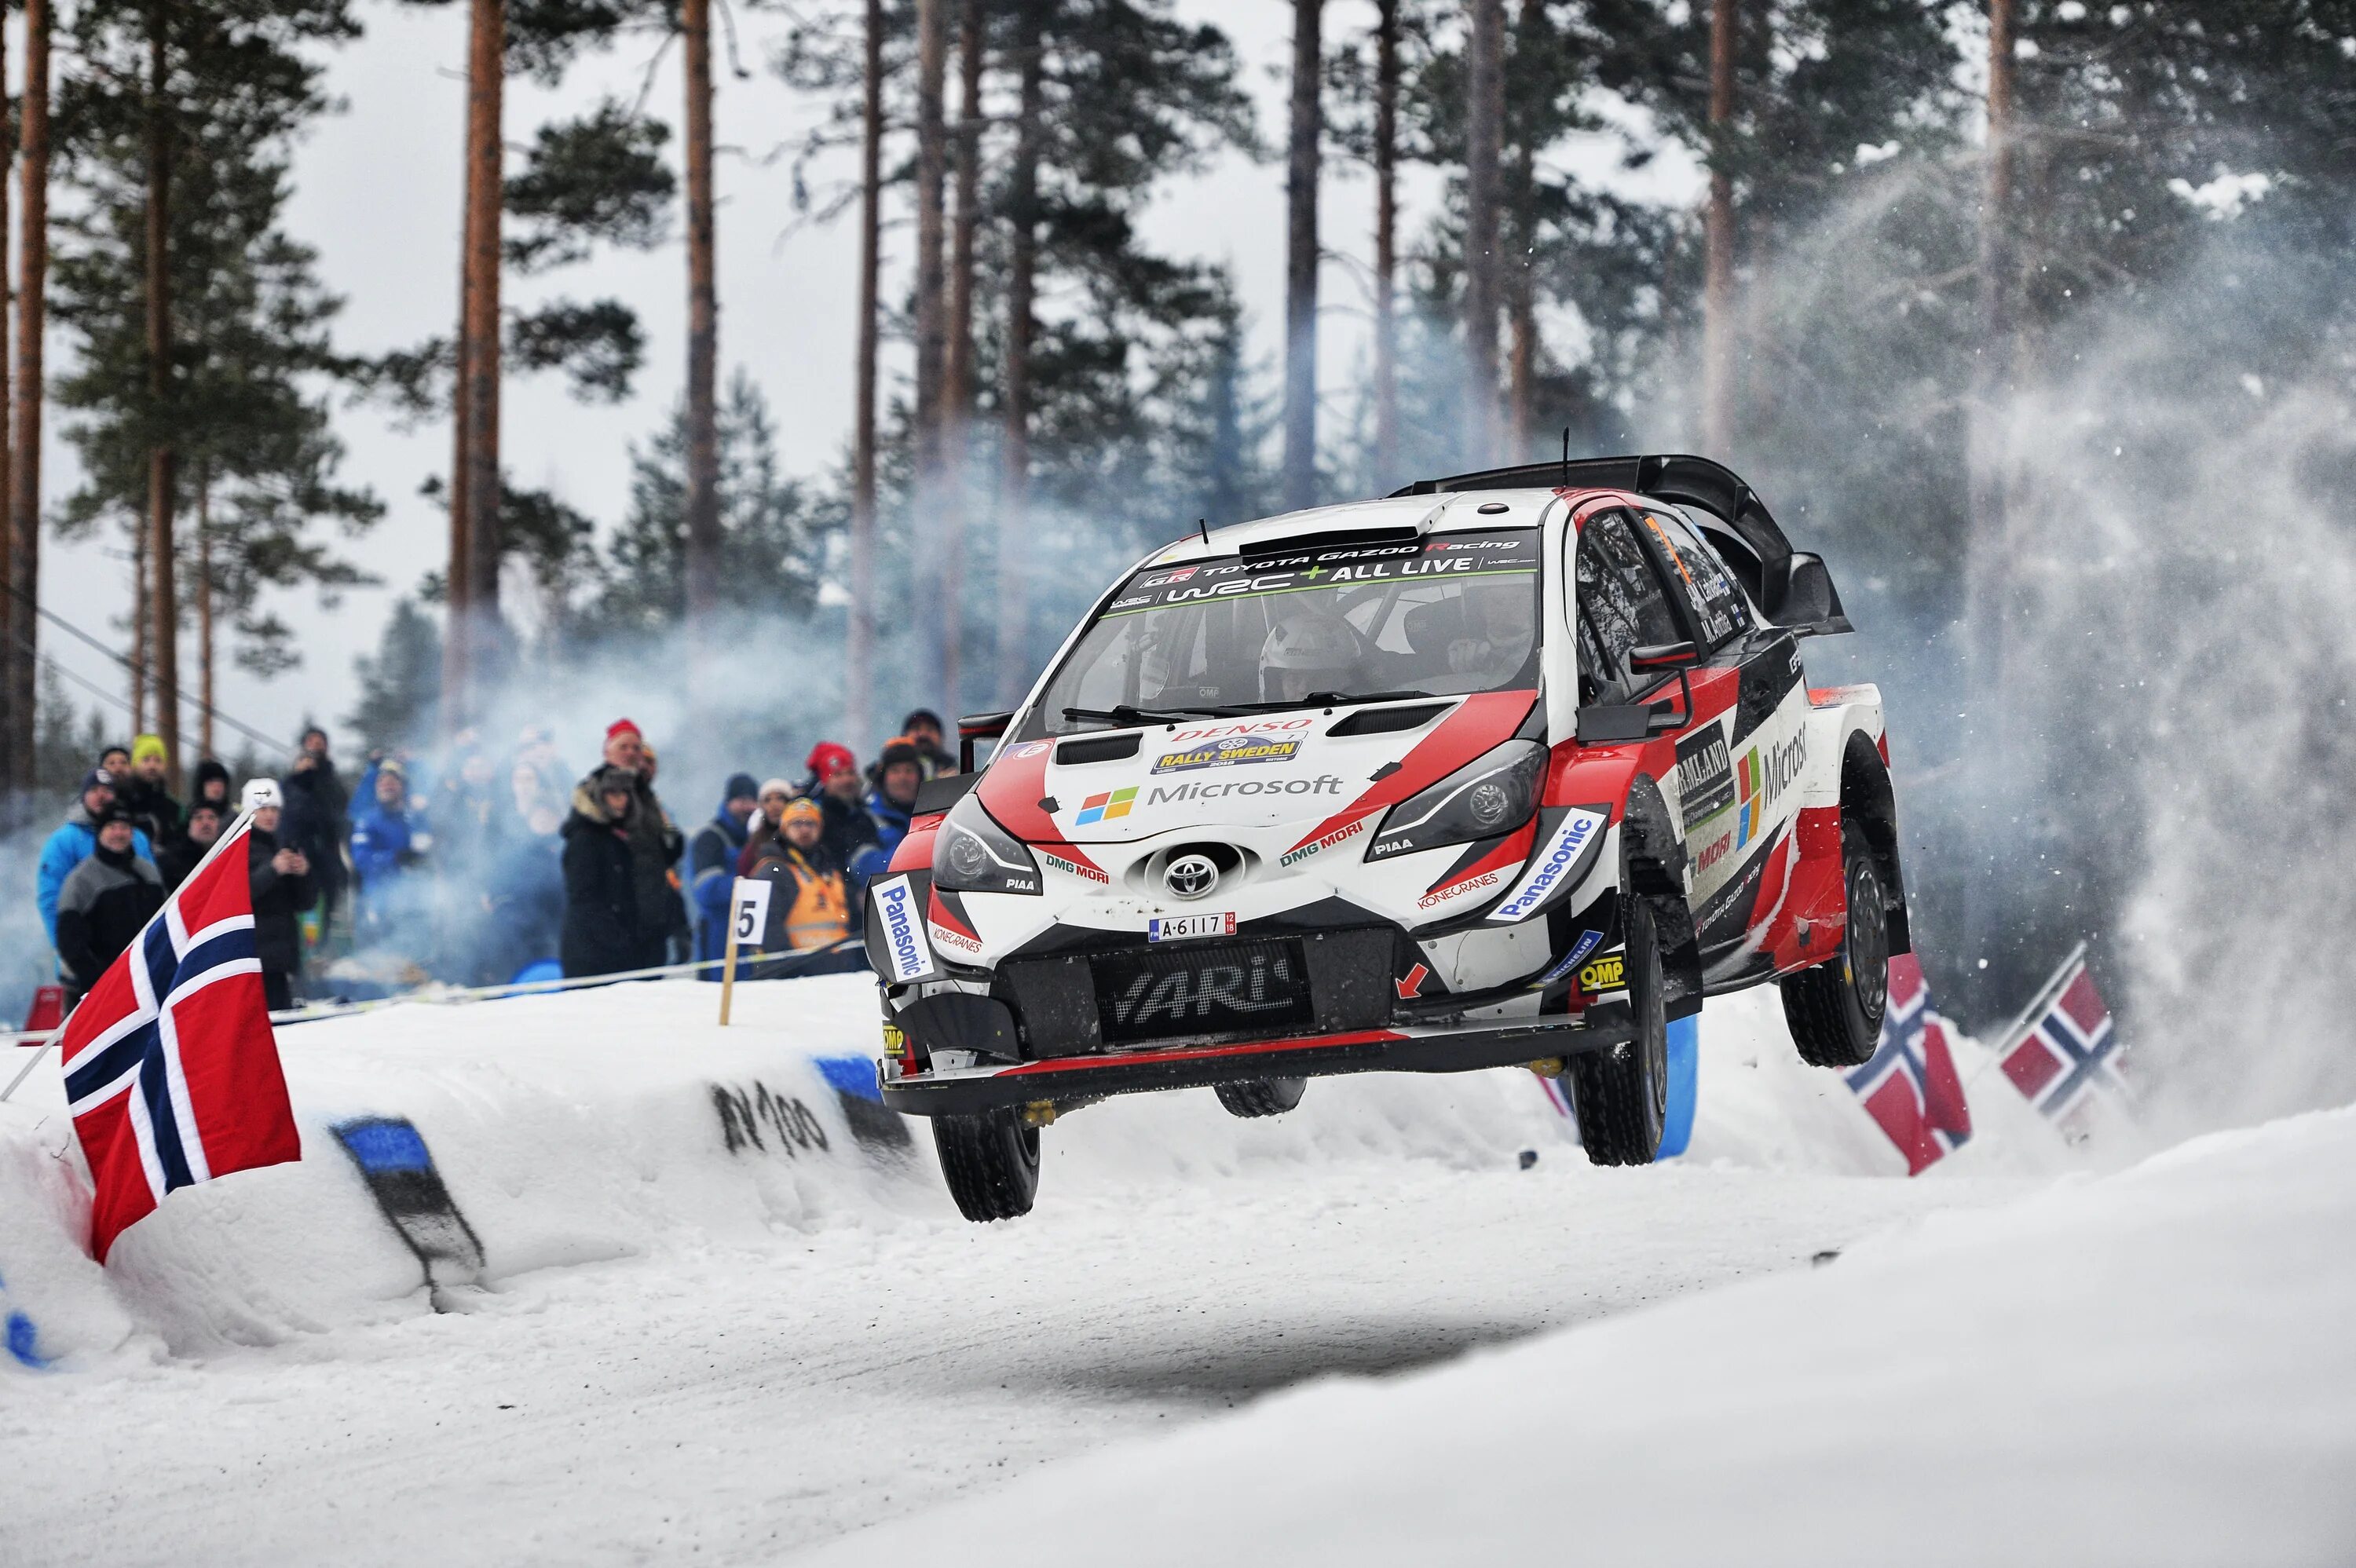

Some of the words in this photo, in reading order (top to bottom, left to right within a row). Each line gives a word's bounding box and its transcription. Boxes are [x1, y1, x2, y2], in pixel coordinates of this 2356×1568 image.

[1203, 555, 1309, 576] TOYOTA
[1317, 545, 1418, 561] GAZOO
[1425, 540, 1520, 553] Racing
[1166, 572, 1295, 602] WRC
[1330, 563, 1391, 581] ALL
[1401, 557, 1474, 575] LIVE
[1172, 718, 1313, 742] DENSO
[1160, 751, 1216, 767] RALLY
[1218, 742, 1296, 759] SWEDEN
[1677, 739, 1729, 795] RMLAND
[1147, 774, 1344, 806] Microsoft
[1279, 842, 1319, 868] DMG
[1319, 821, 1364, 849] MORI
[1374, 839, 1413, 855] PIAA
[1697, 830, 1732, 875] MORI
[1006, 879, 1034, 890] PIAA
[1046, 854, 1074, 873] DMG
[1076, 866, 1110, 885] MORI
[1498, 818, 1593, 916] Panasonic
[1418, 873, 1498, 910] KONECRANES
[737, 901, 756, 938] 5
[882, 885, 926, 977] Panasonic
[1226, 914, 1234, 923] 12
[933, 927, 982, 954] KONECRANES
[1553, 938, 1593, 978] MICHELIN
[1580, 962, 1624, 985] OMP
